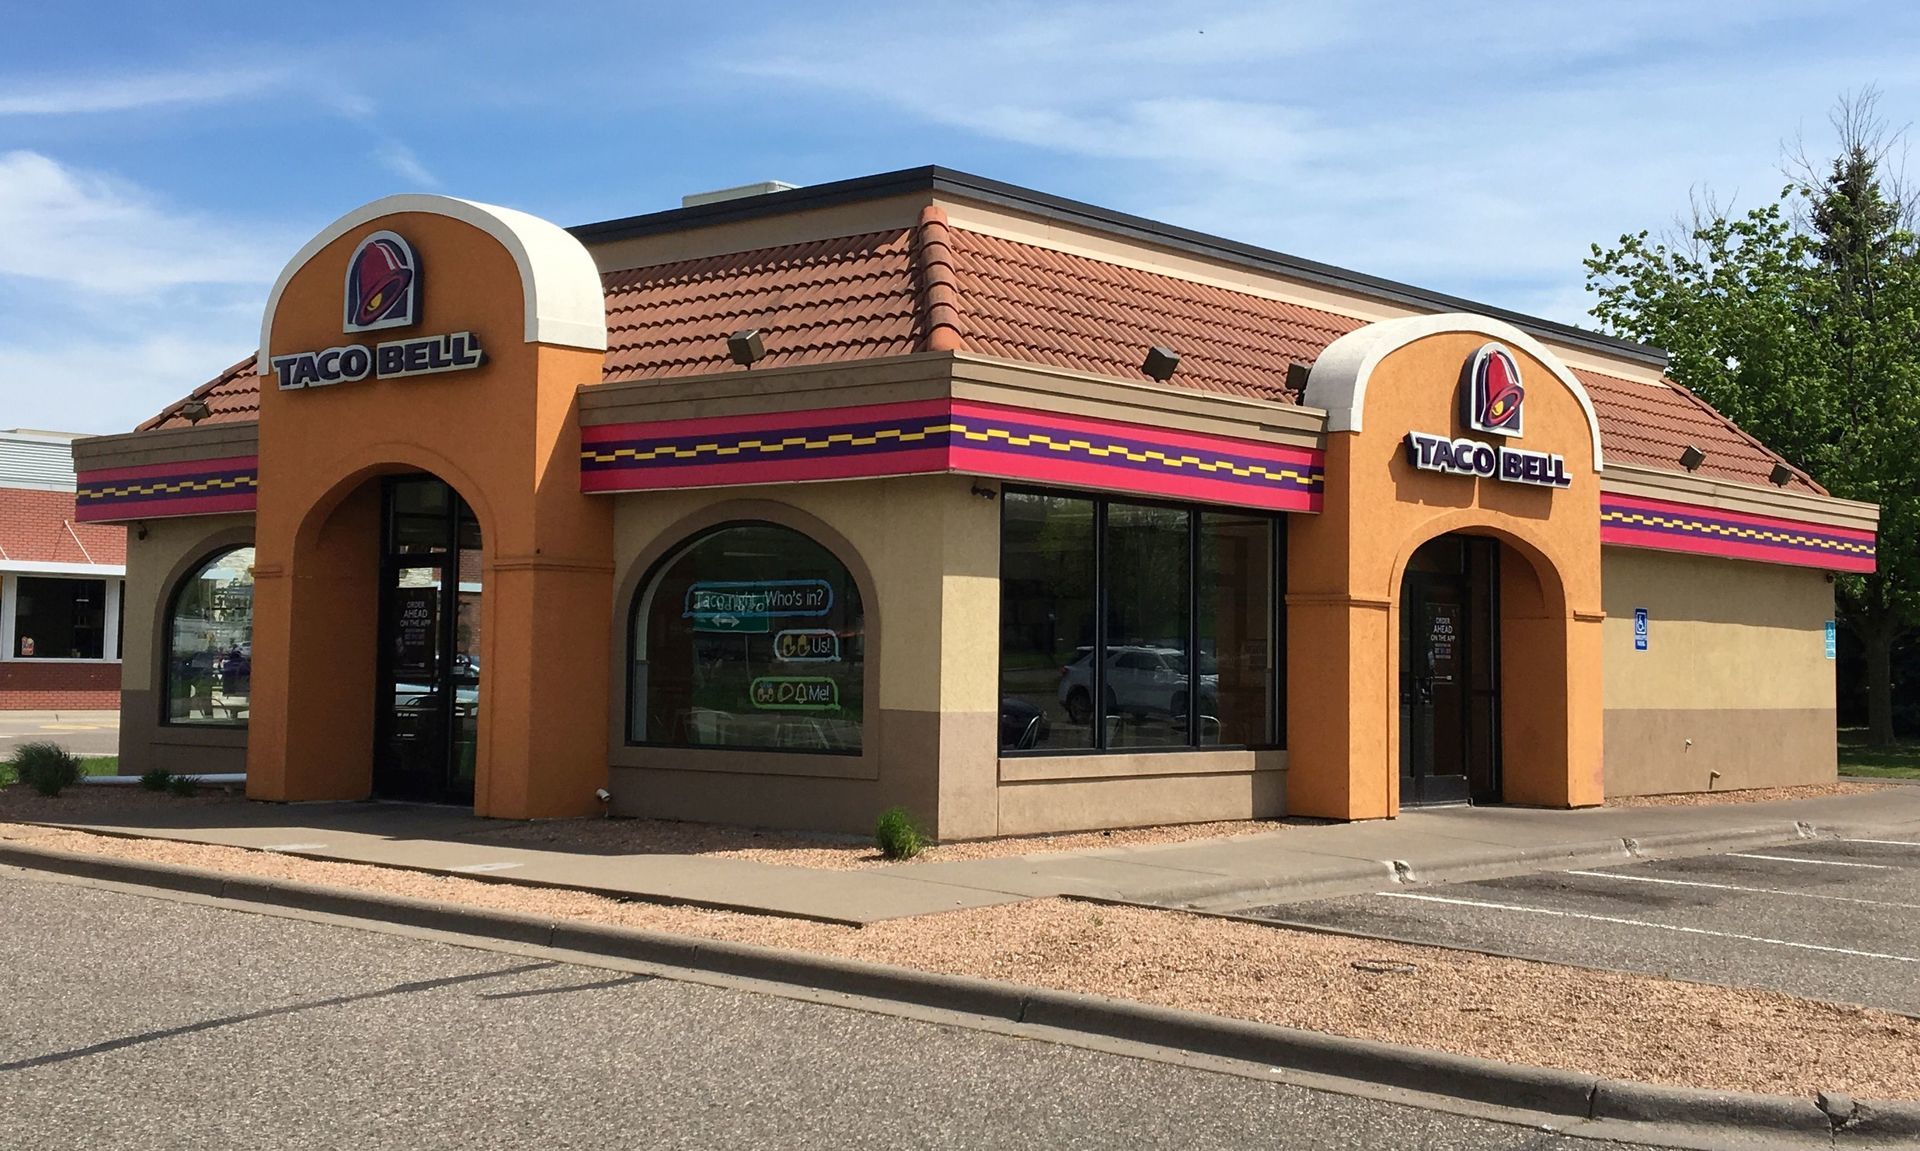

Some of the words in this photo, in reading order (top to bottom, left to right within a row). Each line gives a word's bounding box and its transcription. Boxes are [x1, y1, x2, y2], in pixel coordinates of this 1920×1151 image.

[272, 346, 371, 388] TACO
[377, 333, 481, 377] BELL
[1411, 432, 1496, 477] TACO
[1500, 447, 1572, 488] BELL
[765, 590, 802, 606] Who's
[806, 589, 823, 606] in?
[403, 609, 428, 618] AHEAD
[1433, 625, 1453, 634] AHEAD
[812, 637, 830, 653] Us!
[809, 685, 830, 701] Me!
